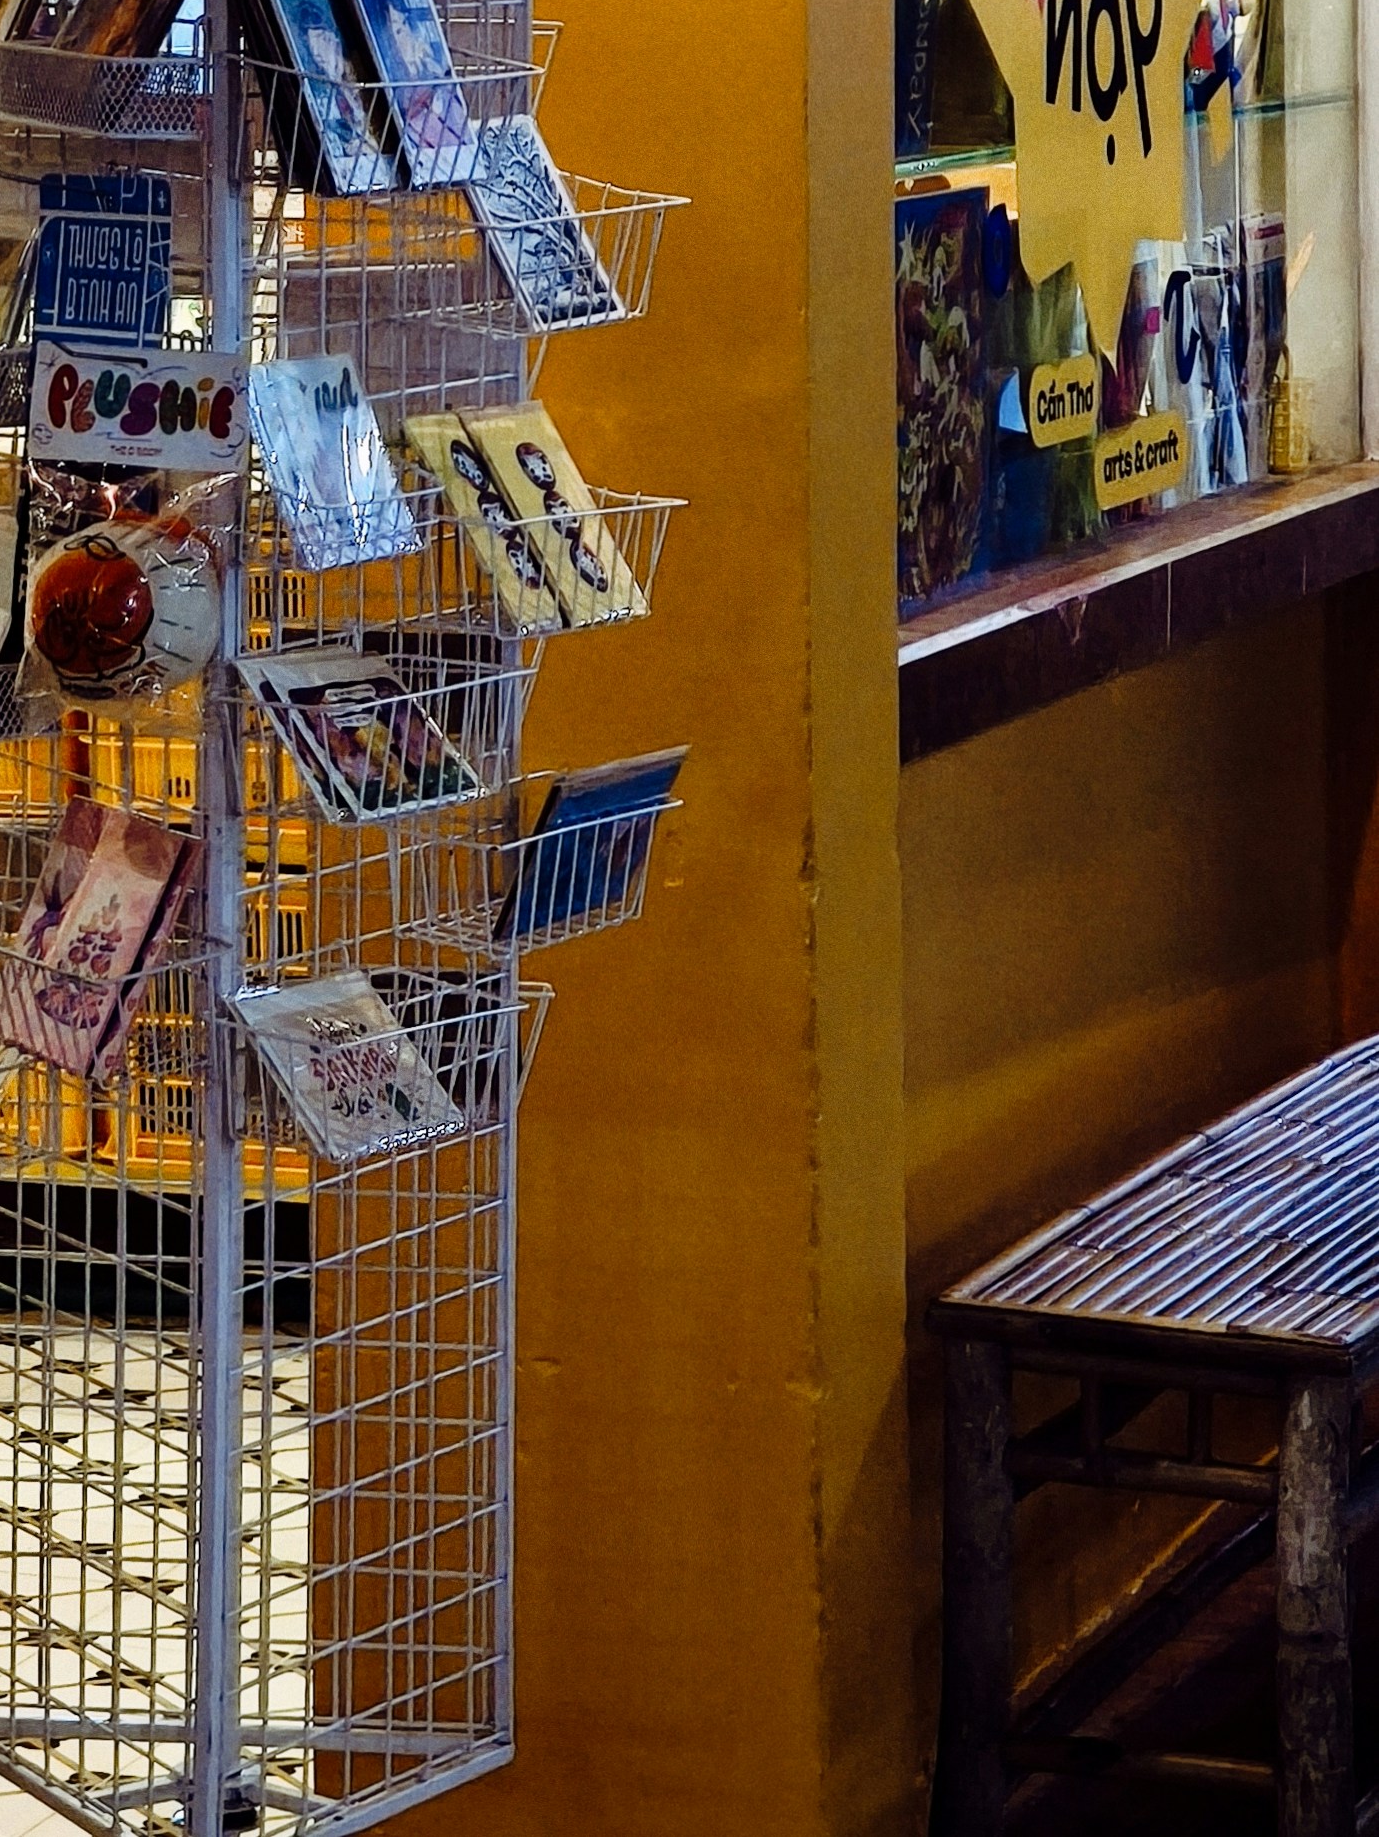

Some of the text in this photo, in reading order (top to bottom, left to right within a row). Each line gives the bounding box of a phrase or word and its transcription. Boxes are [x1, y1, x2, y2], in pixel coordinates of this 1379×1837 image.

[1103, 429, 1179, 484] arts & craft
